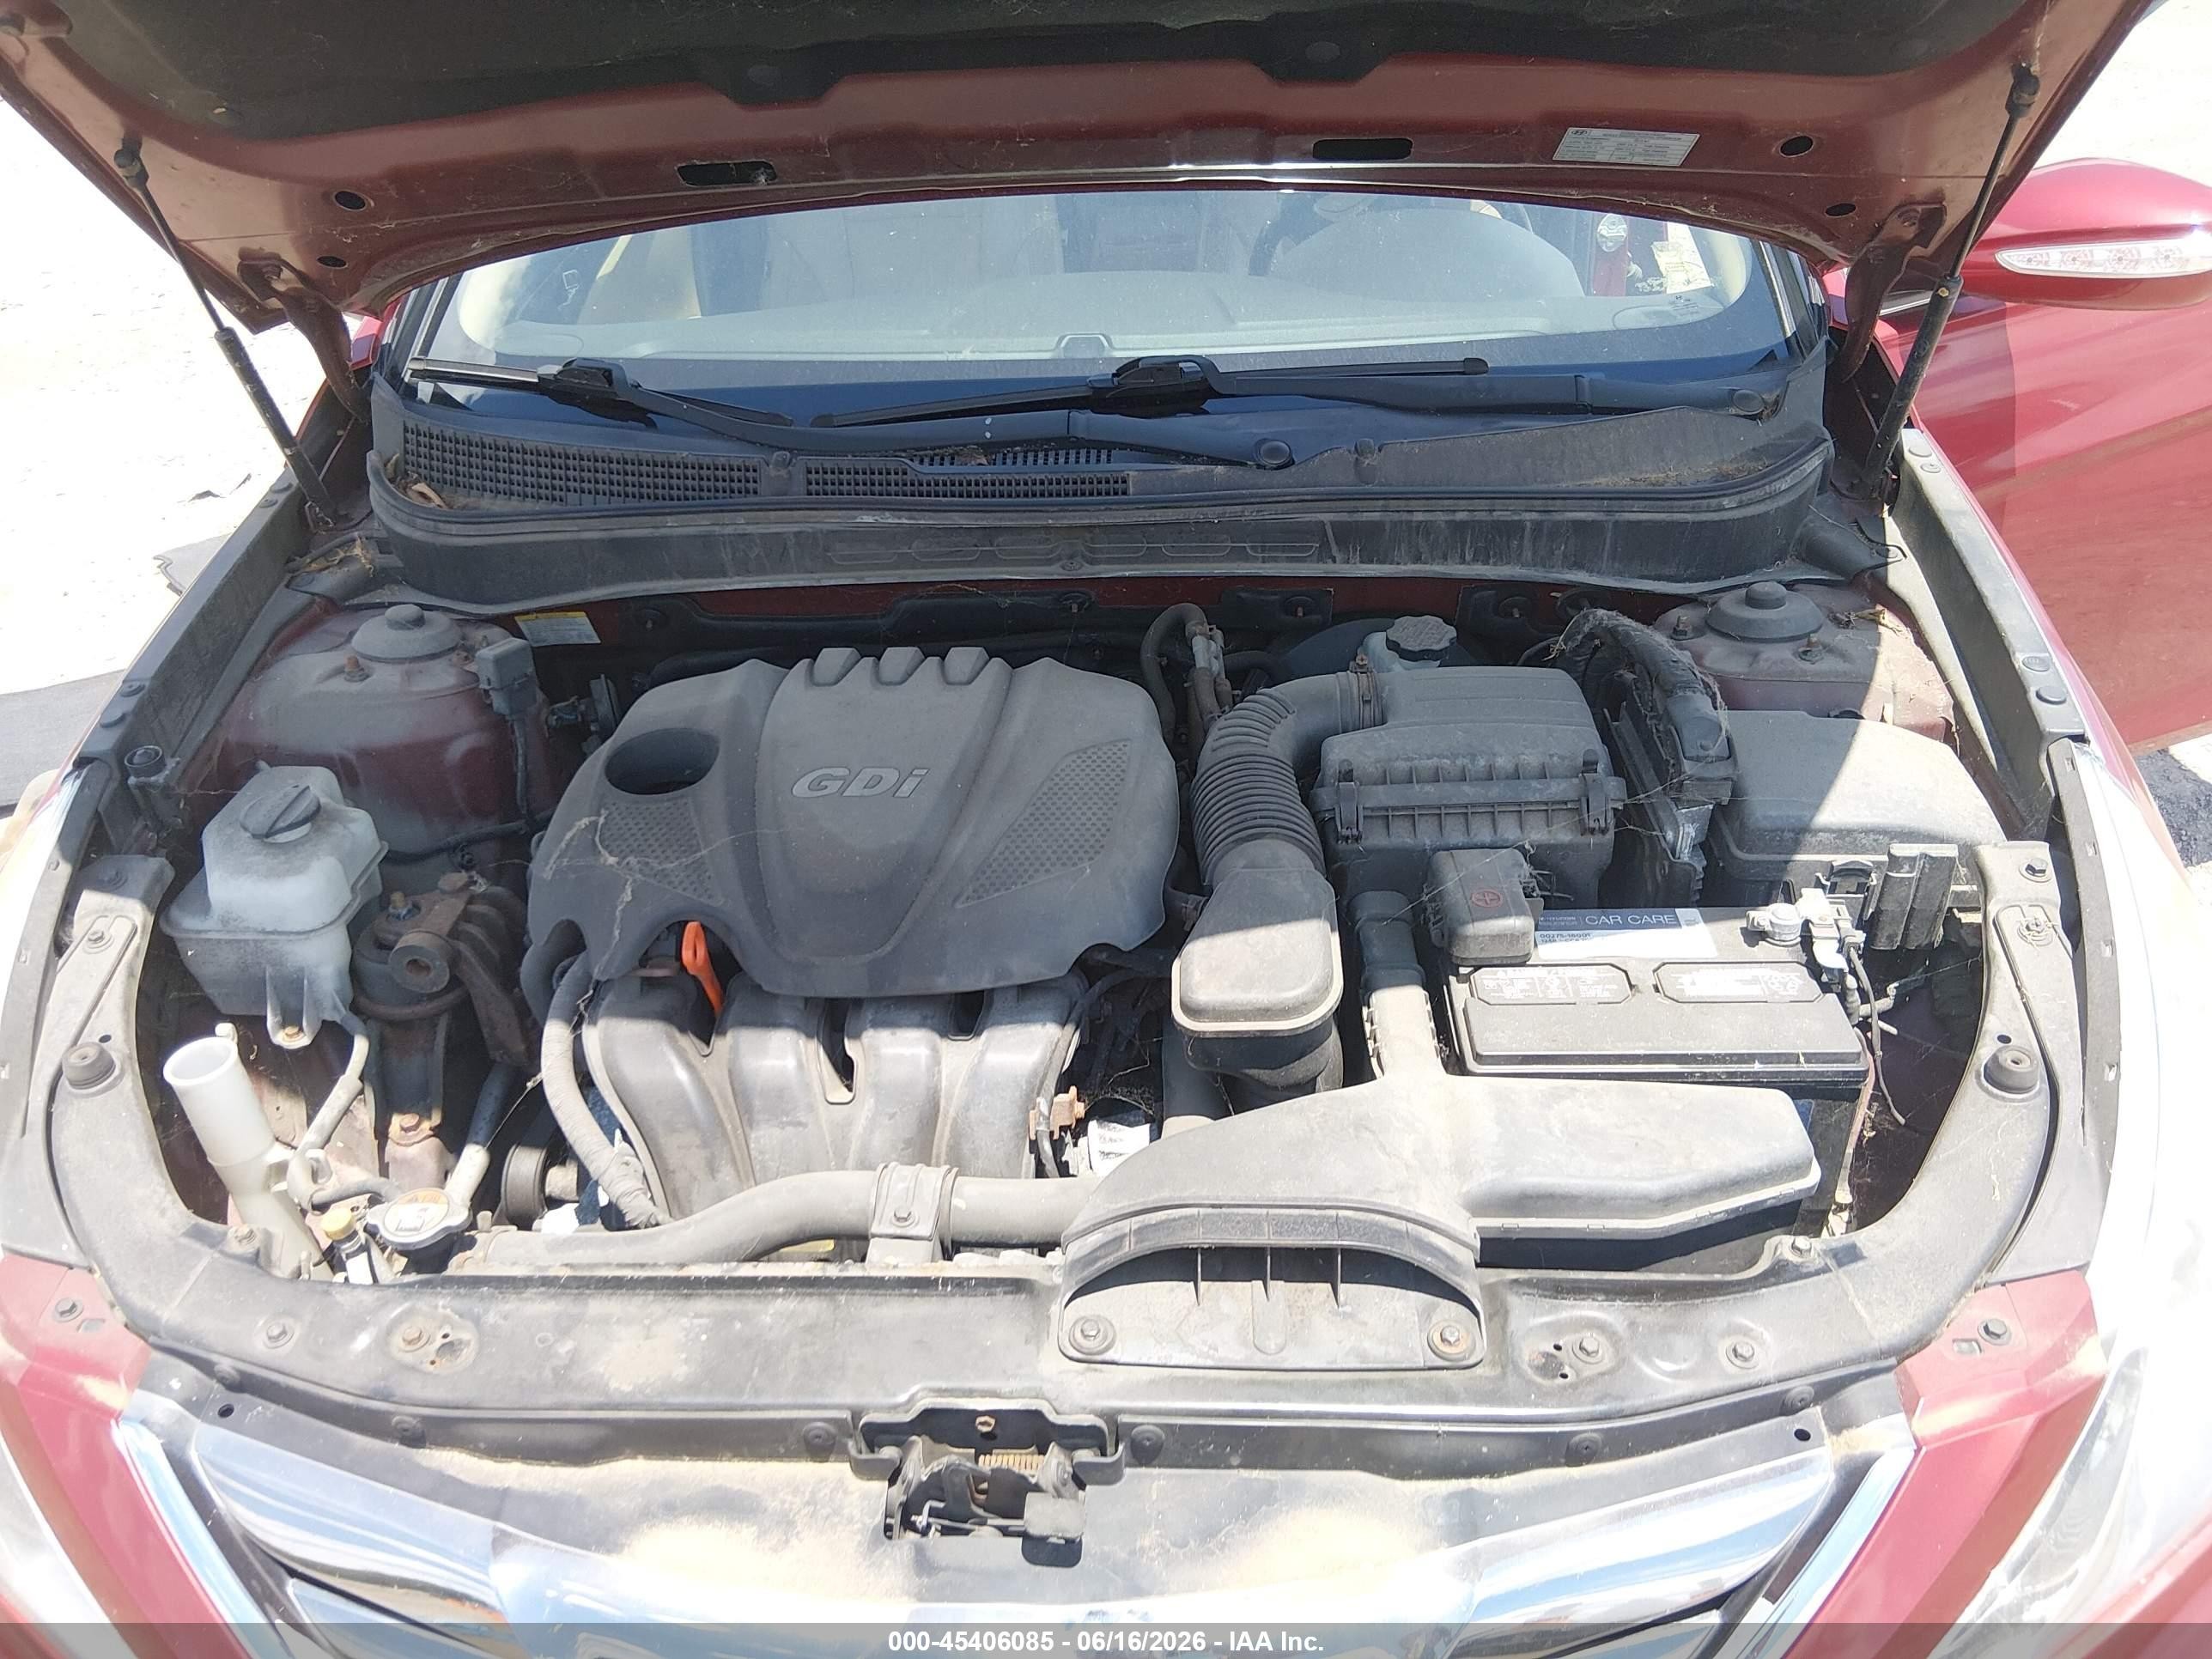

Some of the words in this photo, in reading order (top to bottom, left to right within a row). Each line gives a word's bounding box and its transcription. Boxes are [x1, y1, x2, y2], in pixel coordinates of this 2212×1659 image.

[791, 766, 930, 799] GDi
[1585, 915, 1623, 926] CAR
[1627, 915, 1677, 925] CARE
